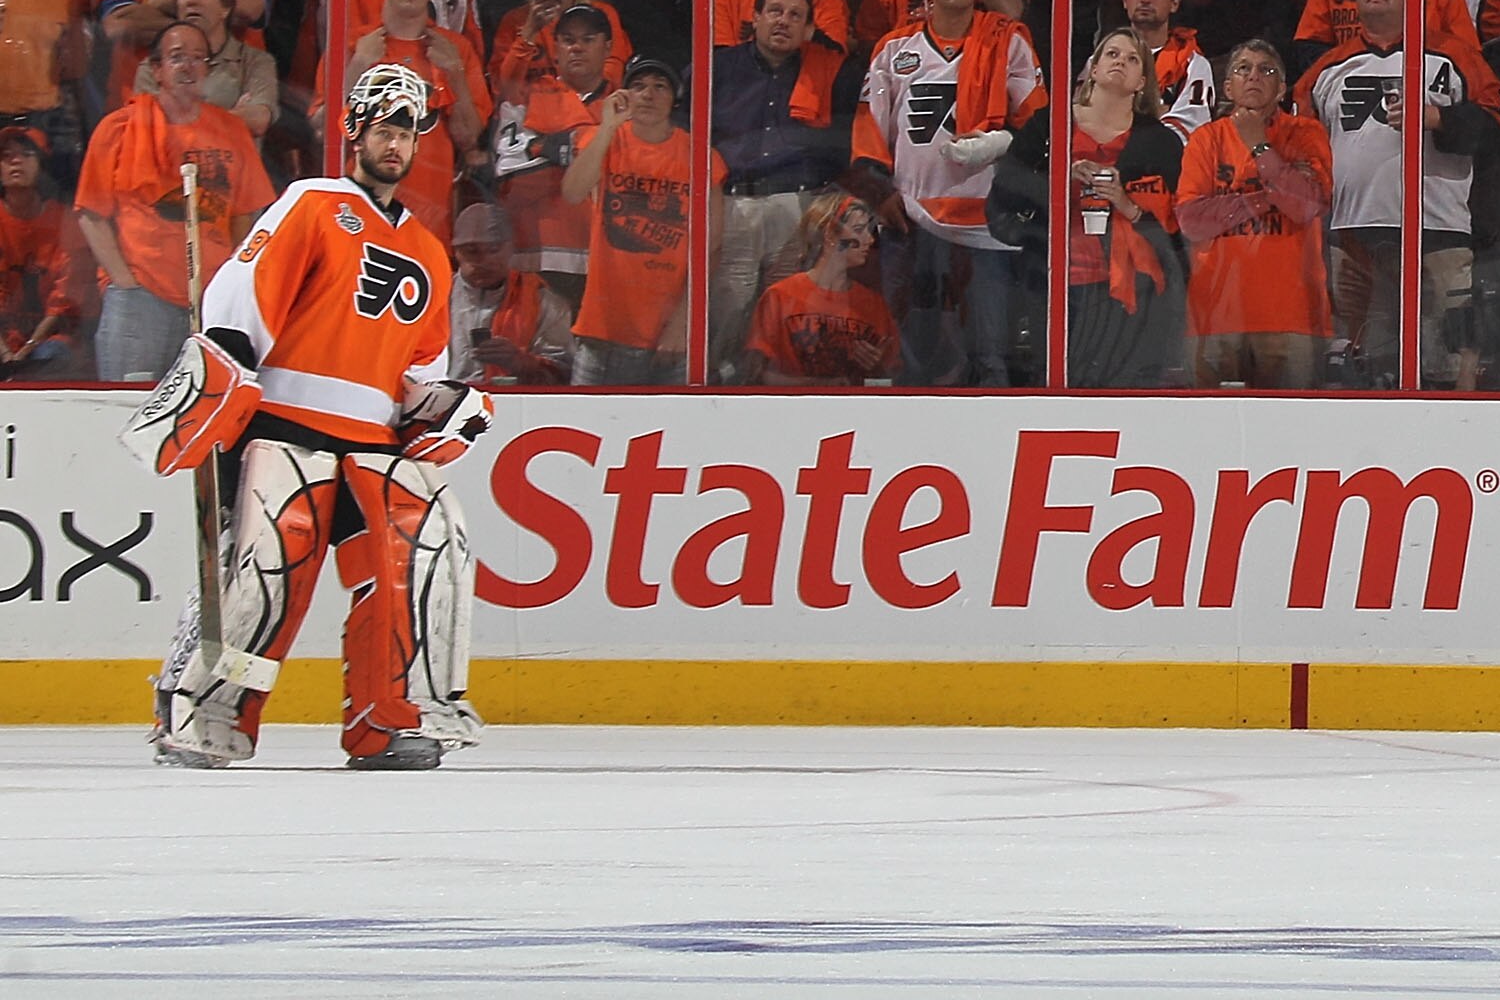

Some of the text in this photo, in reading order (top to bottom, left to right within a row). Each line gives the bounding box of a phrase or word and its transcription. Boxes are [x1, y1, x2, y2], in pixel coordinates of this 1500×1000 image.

[1428, 61, 1453, 97] A
[140, 367, 193, 419] Reebok
[475, 427, 971, 609] State
